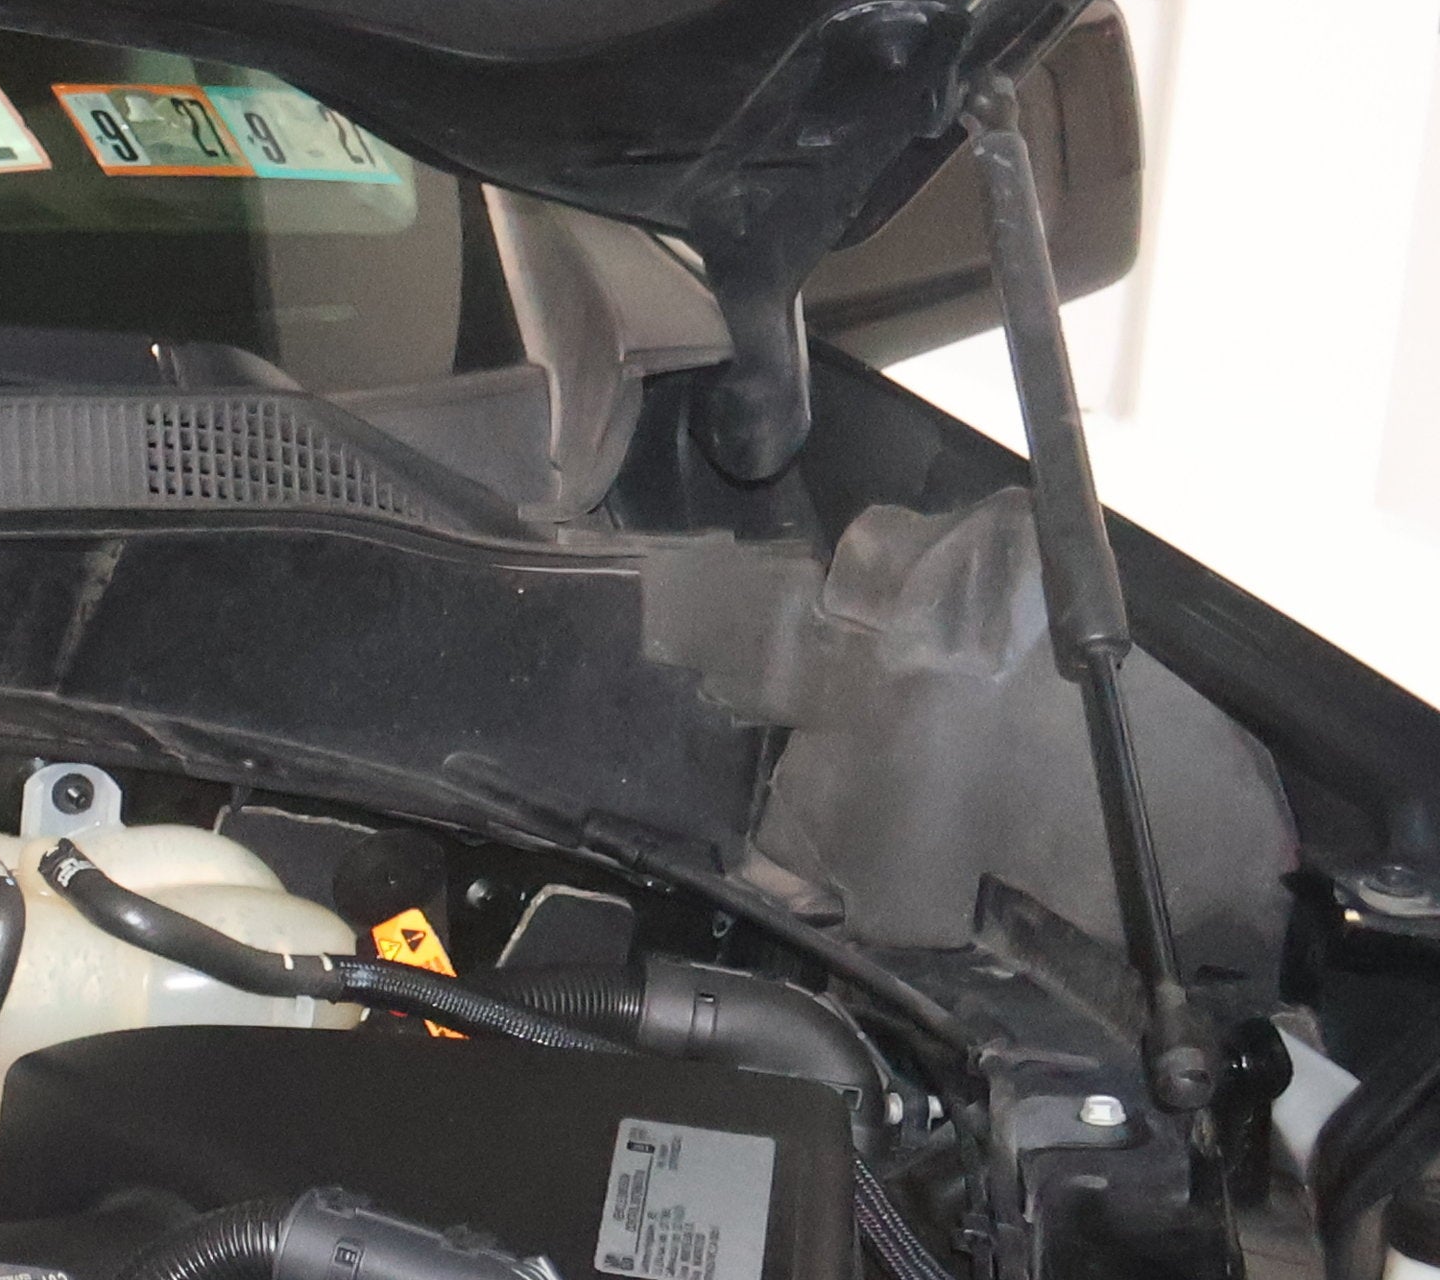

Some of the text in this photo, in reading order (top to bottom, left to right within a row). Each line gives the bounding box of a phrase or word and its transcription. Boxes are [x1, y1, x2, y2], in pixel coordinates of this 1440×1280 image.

[90, 96, 232, 163] 9 27
[243, 112, 287, 164] 9
